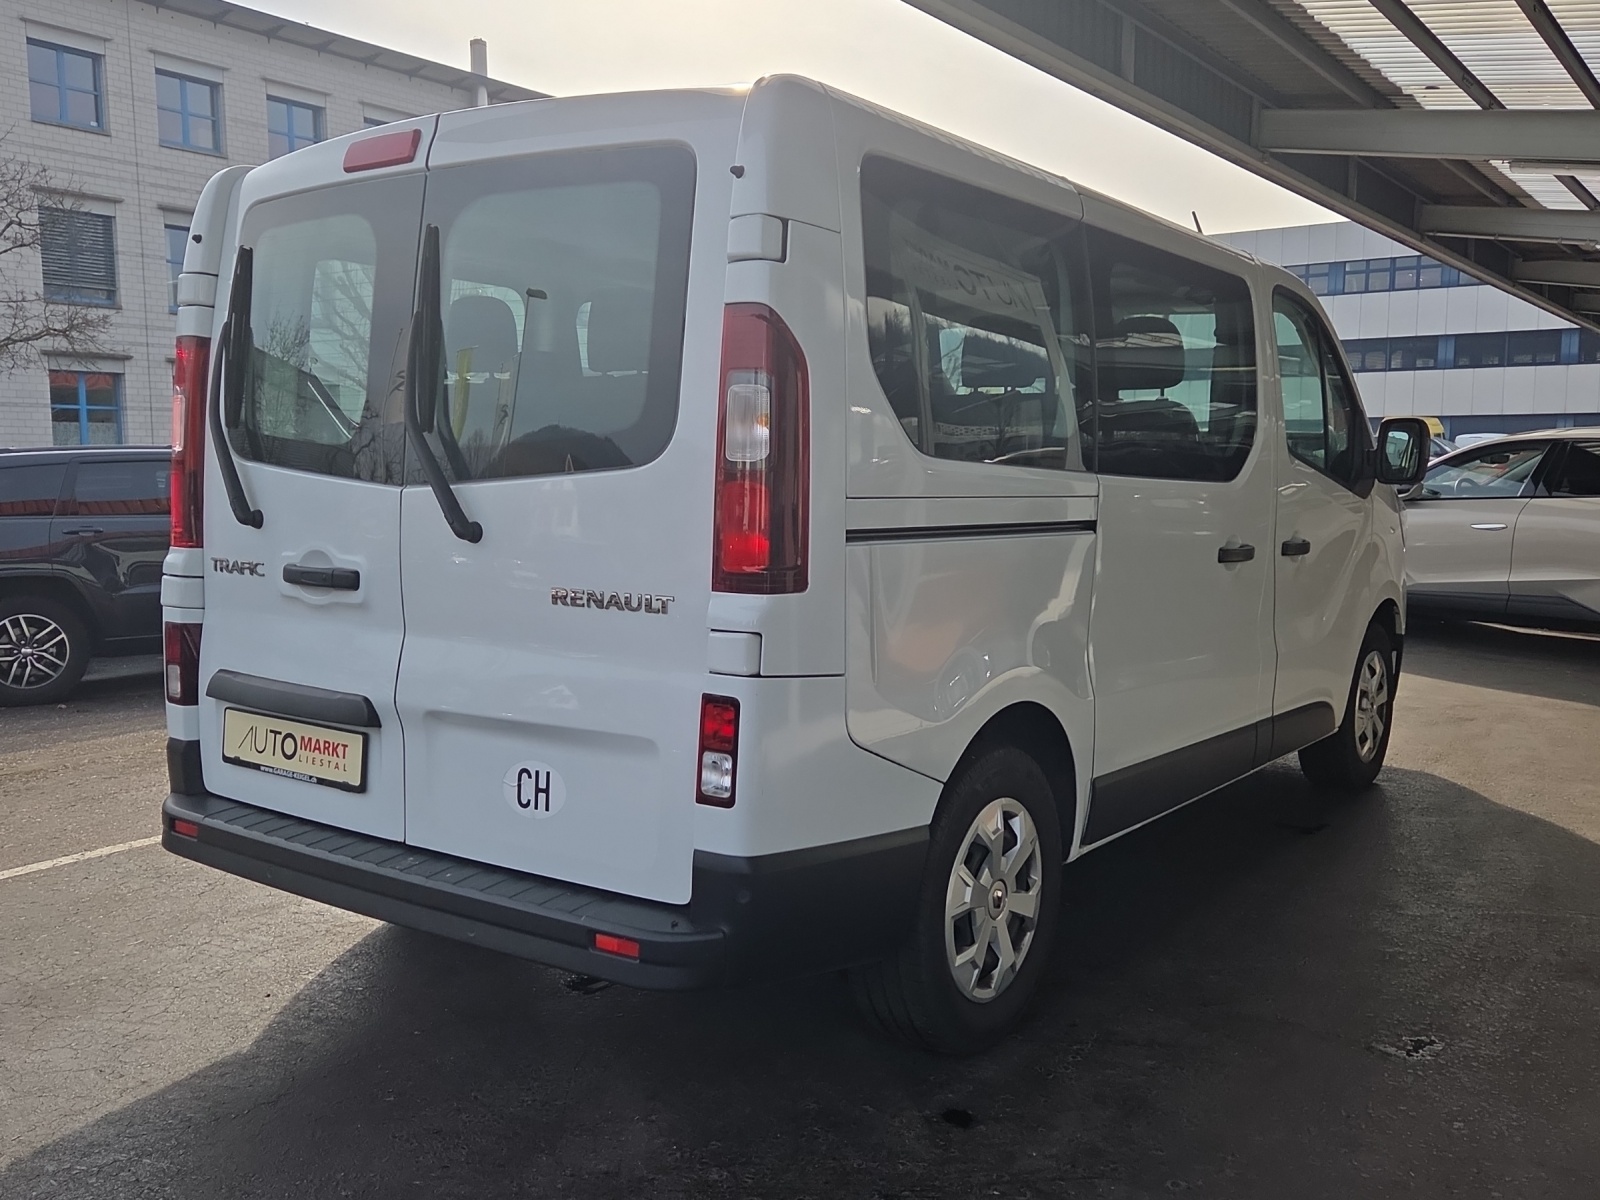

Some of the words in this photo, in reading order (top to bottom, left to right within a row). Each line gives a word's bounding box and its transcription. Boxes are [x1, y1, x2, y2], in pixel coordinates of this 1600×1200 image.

[551, 587, 675, 614] RENAULT
[238, 725, 298, 760] AUTO
[299, 735, 349, 759] MARKT
[298, 754, 348, 772] LIESTAL
[517, 767, 551, 812] CH
